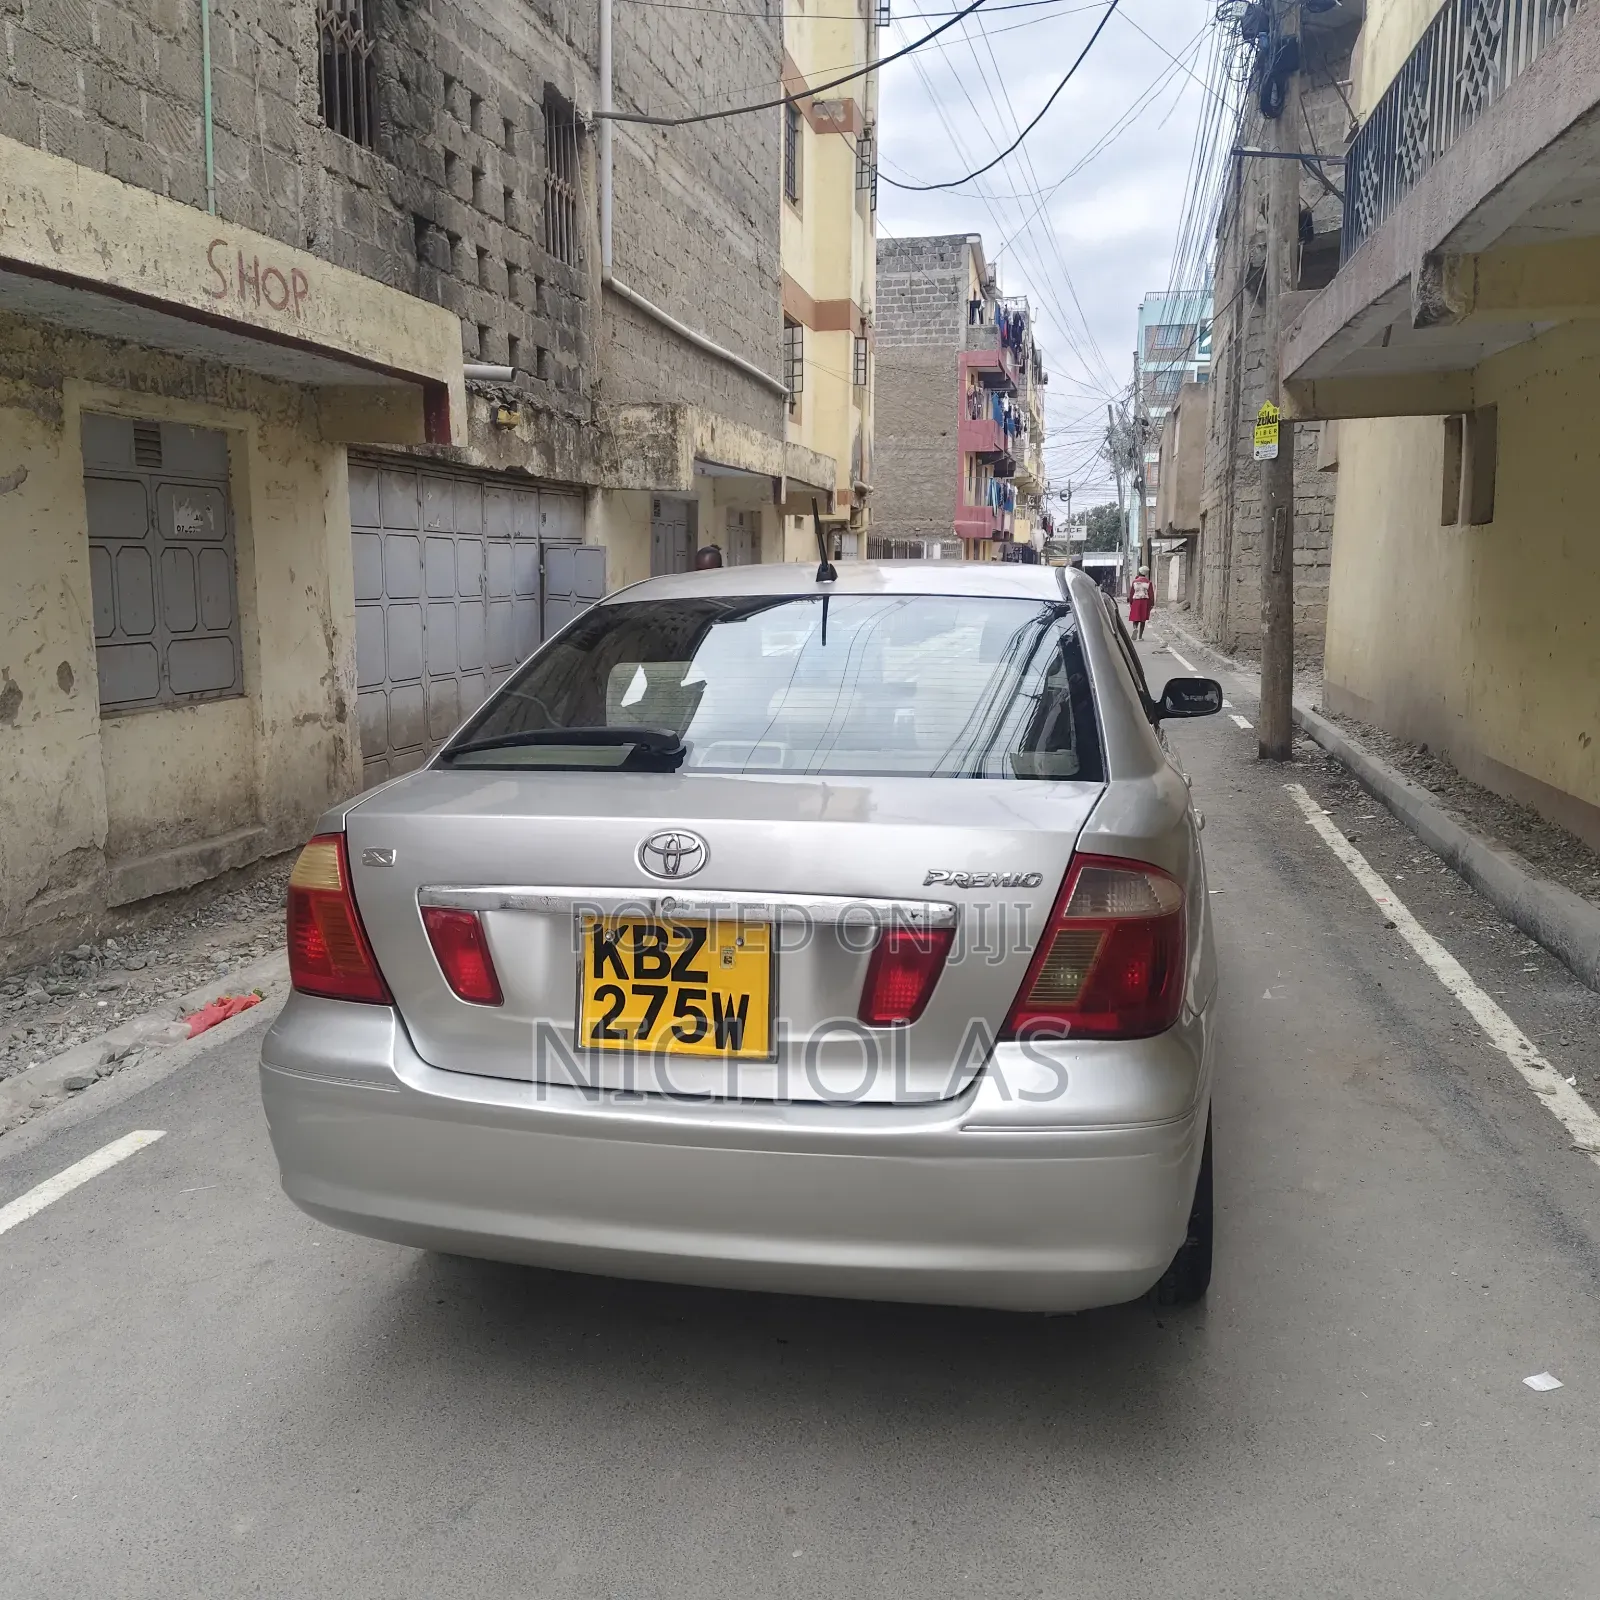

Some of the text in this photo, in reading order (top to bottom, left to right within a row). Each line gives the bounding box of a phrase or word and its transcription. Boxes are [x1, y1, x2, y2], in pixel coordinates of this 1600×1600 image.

[203, 238, 309, 319] SHOP
[922, 868, 1044, 889] PREMIO
[593, 923, 709, 984] KBZ
[590, 984, 750, 1051] 275W
